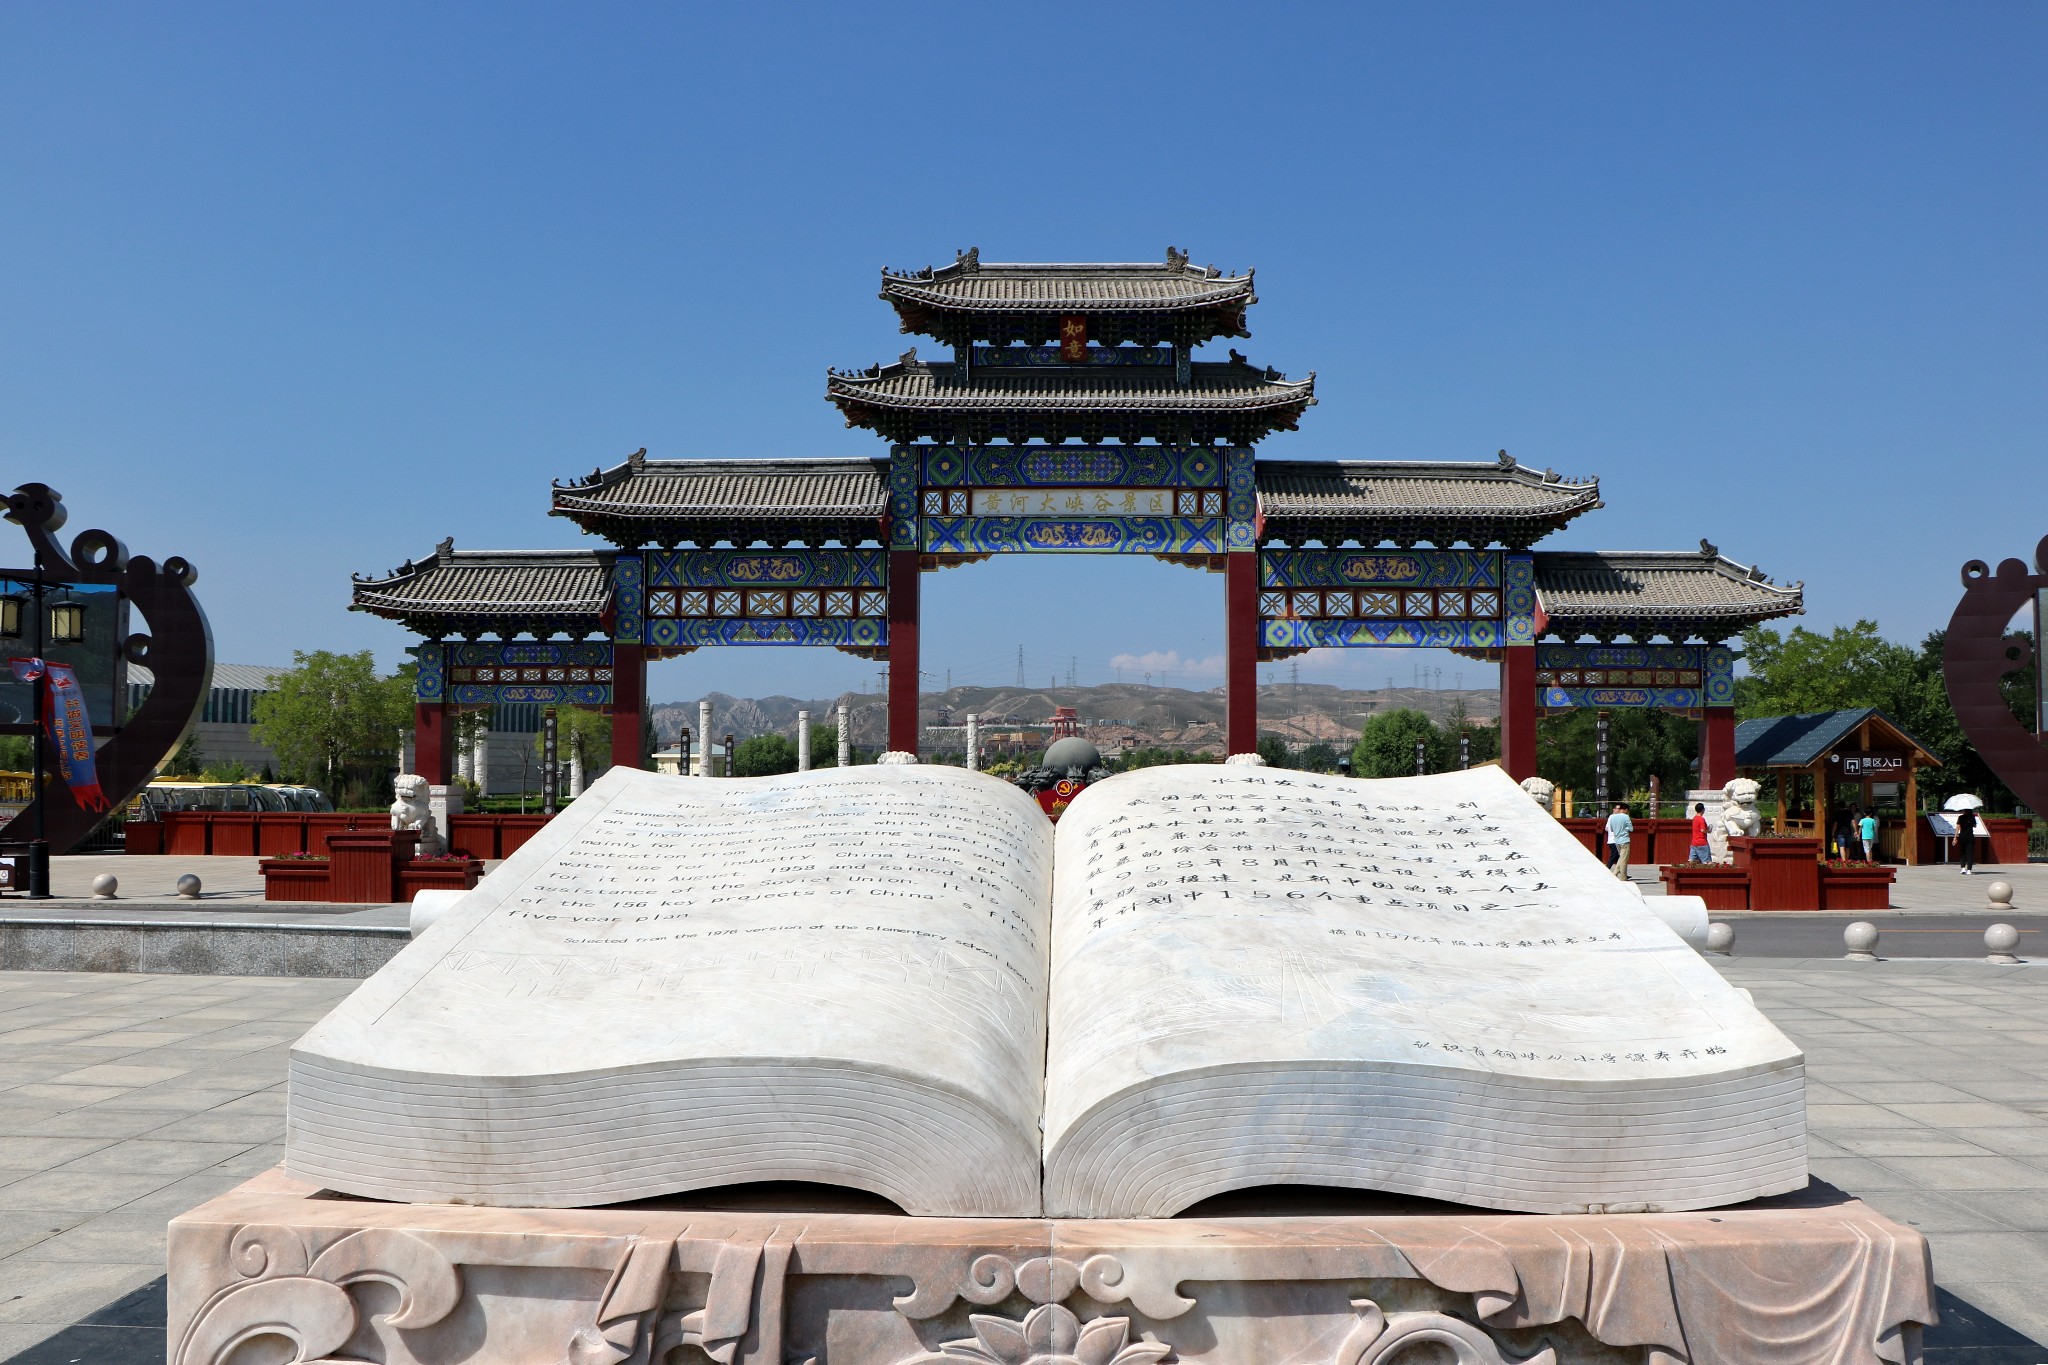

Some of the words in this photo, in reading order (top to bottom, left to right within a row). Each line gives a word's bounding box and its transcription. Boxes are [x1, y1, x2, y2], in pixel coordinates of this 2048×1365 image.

[1062, 320, 1084, 359] 如意
[980, 492, 1165, 514] 黄河大峡谷景区
[1862, 757, 1902, 768] 景区入口
[769, 780, 887, 792] hydropower
[901, 780, 984, 793] station
[1210, 777, 1358, 794] 水利发电站
[612, 809, 709, 818] Sanmenxia
[719, 803, 824, 817] hydropower
[937, 804, 969, 812] are
[674, 820, 735, 829] Yellow
[815, 810, 867, 819] Among
[580, 840, 641, 849] mainly
[651, 841, 680, 849] for
[803, 830, 904, 839] generating
[648, 828, 758, 838] hydropower
[873, 820, 931, 828] which
[976, 830, 1019, 850] used
[569, 850, 688, 860] protection
[700, 849, 746, 858] from
[759, 842, 817, 853] flood
[972, 851, 1006, 868] and
[548, 872, 583, 881] for
[598, 875, 620, 883] it
[634, 875, 657, 883] in
[769, 863, 817, 874] 1958
[828, 863, 867, 871] and
[879, 864, 955, 877] gained
[968, 875, 1002, 893] the
[558, 861, 616, 870] water
[674, 863, 706, 871] for
[835, 851, 894, 859] China
[906, 853, 965, 866] broke
[976, 866, 1038, 908] ground
[507, 909, 624, 924] five-year
[533, 884, 659, 896] assistance
[670, 885, 698, 895] of
[711, 882, 746, 892] the
[759, 875, 836, 888] Soviet
[942, 881, 965, 893] It
[979, 891, 1000, 906] is
[1010, 909, 1038, 938] one
[519, 897, 548, 905] of
[560, 900, 597, 909] the
[611, 901, 648, 909] 156
[659, 899, 699, 909] key
[710, 889, 817, 905] projects
[828, 887, 857, 896] of
[988, 910, 1039, 952] first
[563, 936, 629, 945] Selected
[634, 935, 668, 944] from
[674, 932, 699, 941] the
[706, 927, 739, 938] 1976
[745, 924, 802, 934] version
[832, 923, 859, 931] the
[865, 924, 948, 941] elementary
[954, 938, 999, 960] school
[1412, 1041, 1727, 1064] 认识青铜峡从小学课本开始
